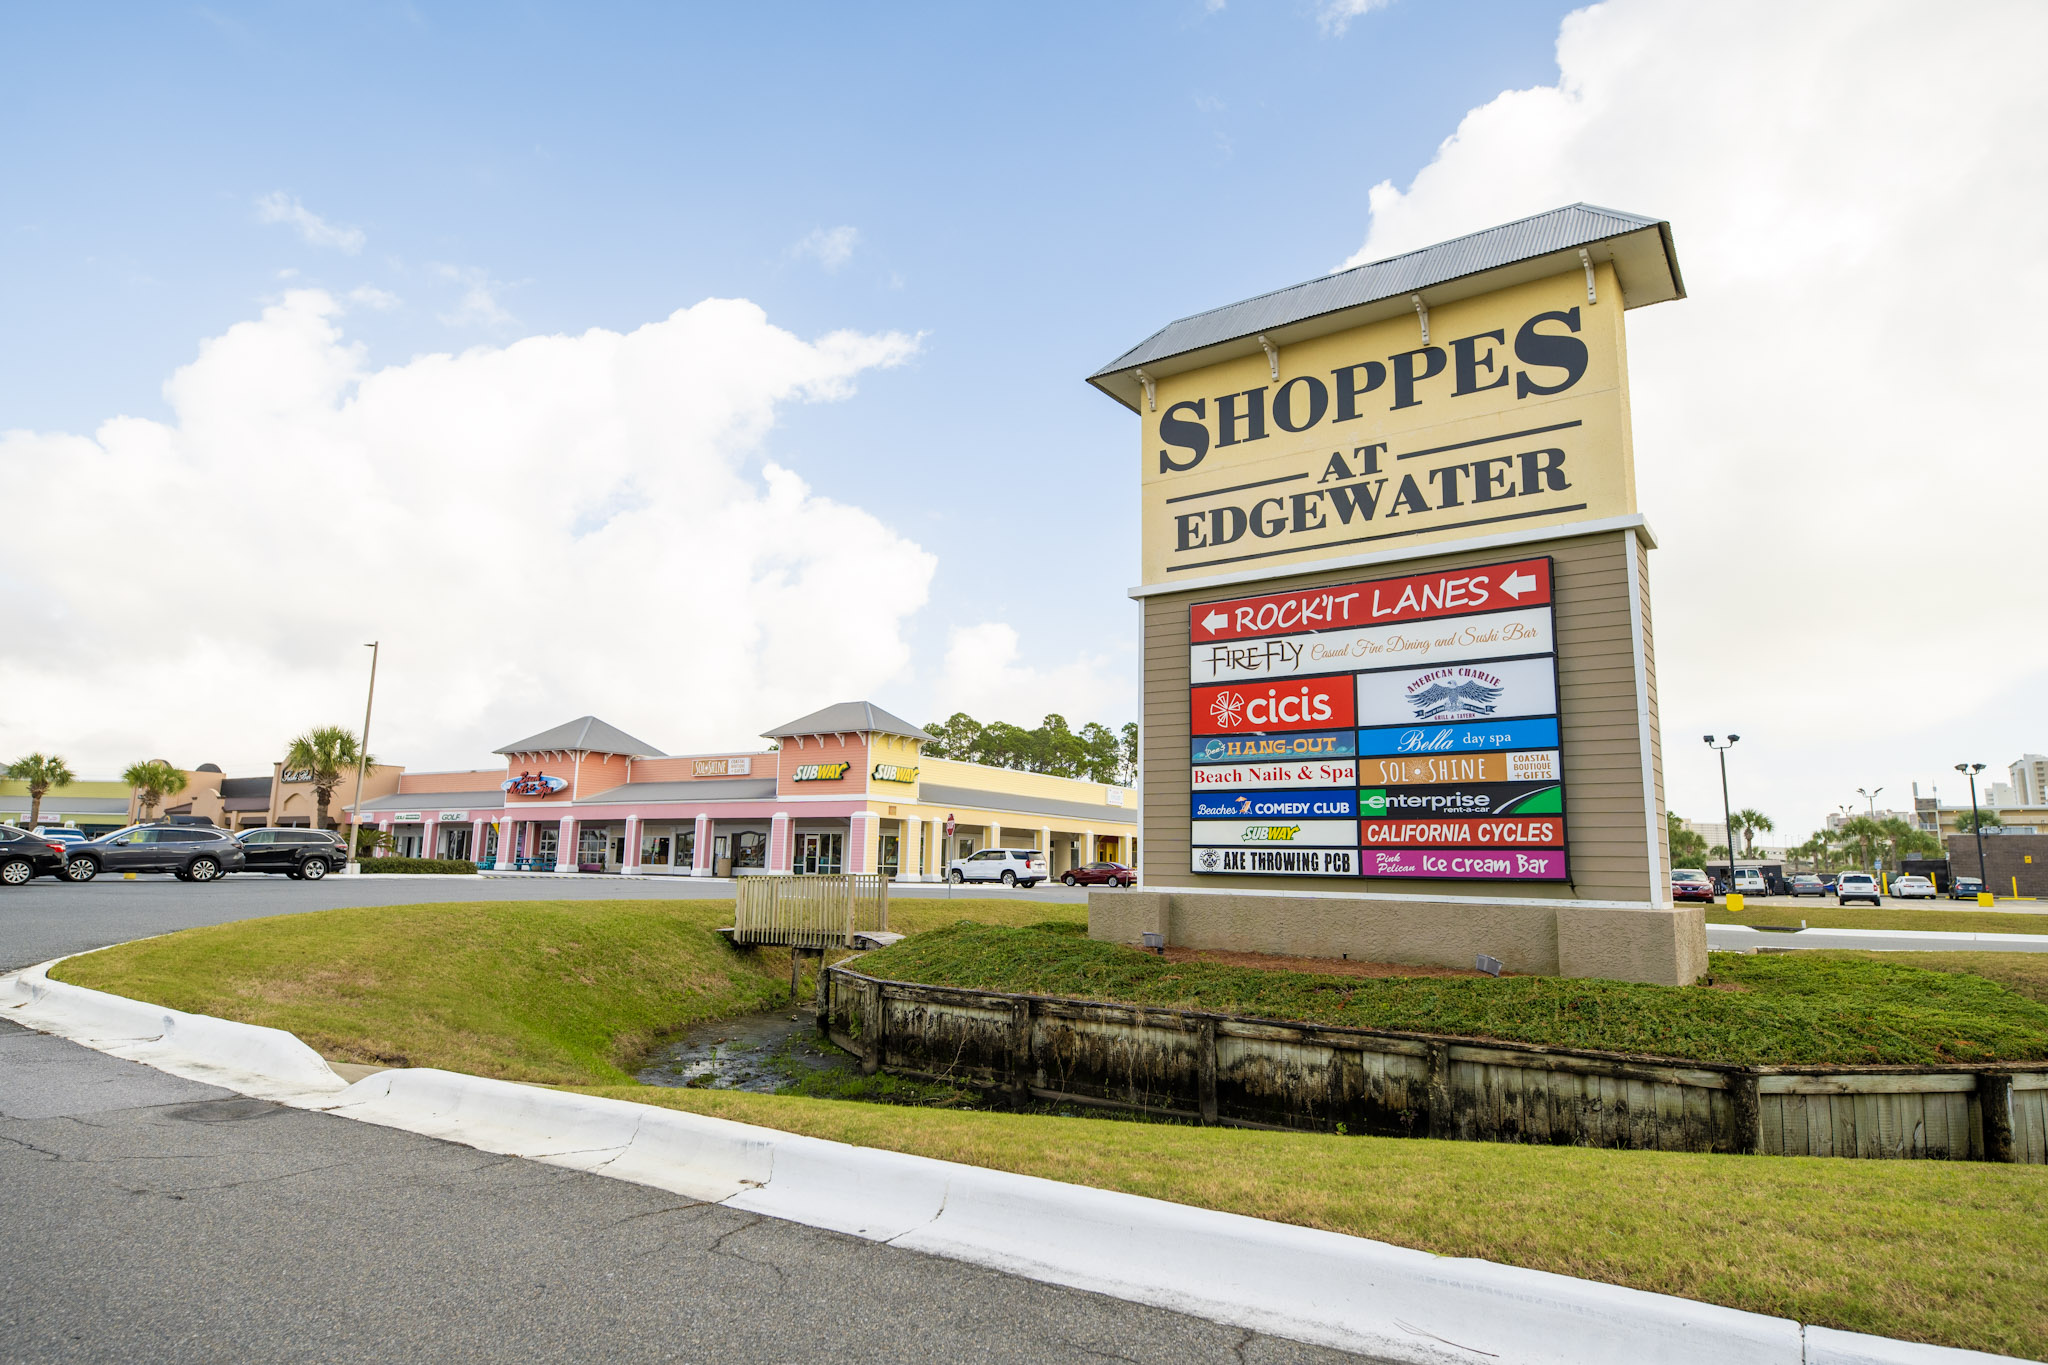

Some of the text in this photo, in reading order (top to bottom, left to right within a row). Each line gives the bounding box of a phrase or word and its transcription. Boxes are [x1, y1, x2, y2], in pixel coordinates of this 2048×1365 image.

[1159, 306, 1589, 475] SHOPPES
[1317, 442, 1388, 484] AT
[1174, 448, 1572, 552] EDGEWATER
[1235, 576, 1490, 632] ROCK'IT LANES
[1310, 643, 1350, 661] Casual
[1351, 639, 1384, 657] Fine
[1386, 635, 1431, 655] Dining
[1434, 632, 1457, 647] and
[1458, 626, 1500, 646] Sushi
[1502, 623, 1539, 641] Bar
[1407, 667, 1501, 693] AMERICAN CHARLIE
[1246, 686, 1333, 725] cicis
[1227, 737, 1337, 756] HANG-OUT
[1397, 728, 1512, 752] Bella day spa
[1513, 754, 1551, 762] COASTAL
[1513, 762, 1552, 771] BOUTIQUE
[792, 761, 851, 783] SUBWAY
[872, 764, 919, 784] SUBWAY
[1194, 764, 1354, 784] Beach Nails & Spa
[1379, 758, 1487, 784] SOL SHINE
[1197, 802, 1350, 815] Beaches COMEDY CLUB
[1366, 791, 1490, 811] enterprise
[1443, 806, 1490, 814] rent-a-car
[441, 813, 461, 821] GOLF
[1241, 824, 1301, 842] SUBWAY
[1367, 822, 1554, 843] CALIFORNIA CYCLES
[1223, 851, 1246, 870] AXE
[1250, 851, 1319, 872] THROWING
[1324, 852, 1350, 873] PCB
[1375, 852, 1401, 863] Pink
[1422, 855, 1447, 872] Ice
[1516, 854, 1549, 874] Bar
[1377, 863, 1416, 874] Pelican
